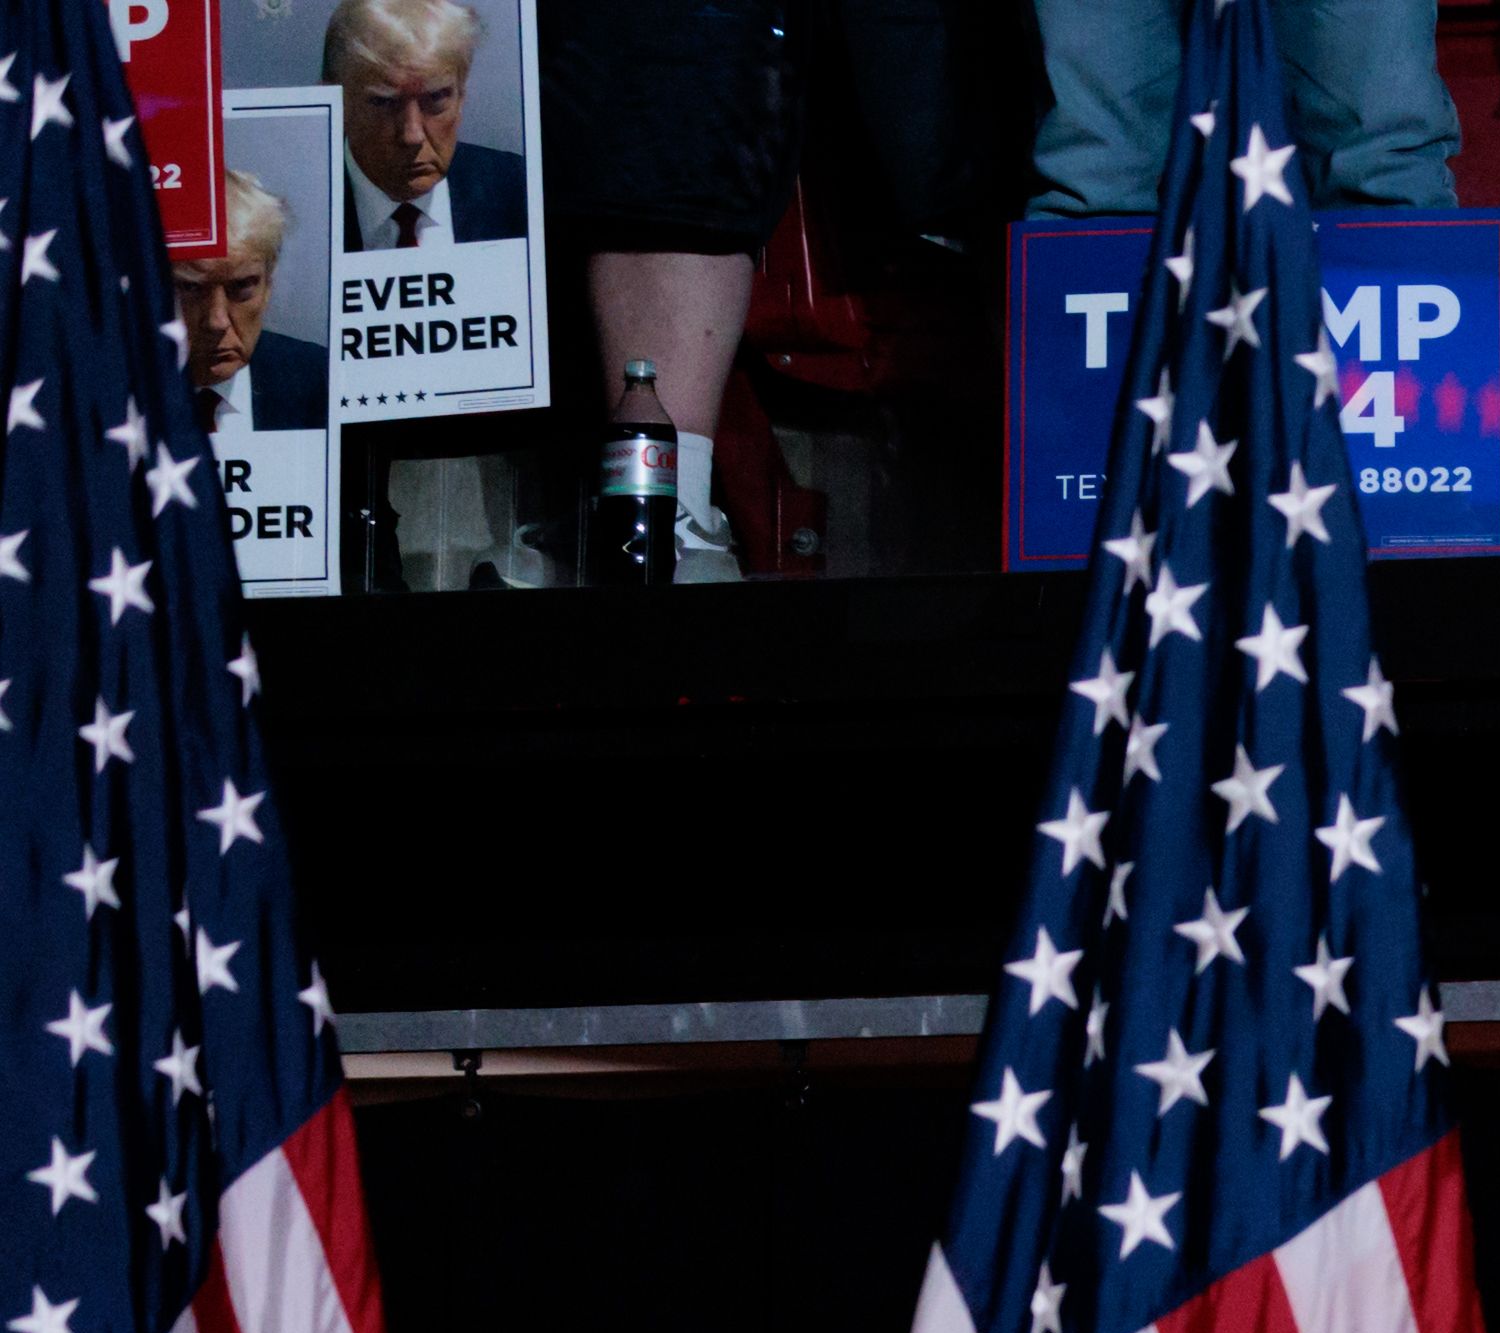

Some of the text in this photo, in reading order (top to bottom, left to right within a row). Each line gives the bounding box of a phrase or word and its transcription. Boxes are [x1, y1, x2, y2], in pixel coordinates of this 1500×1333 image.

[343, 273, 455, 313] EVER
[341, 315, 518, 361] RENDER
[1359, 466, 1473, 494] 88022
